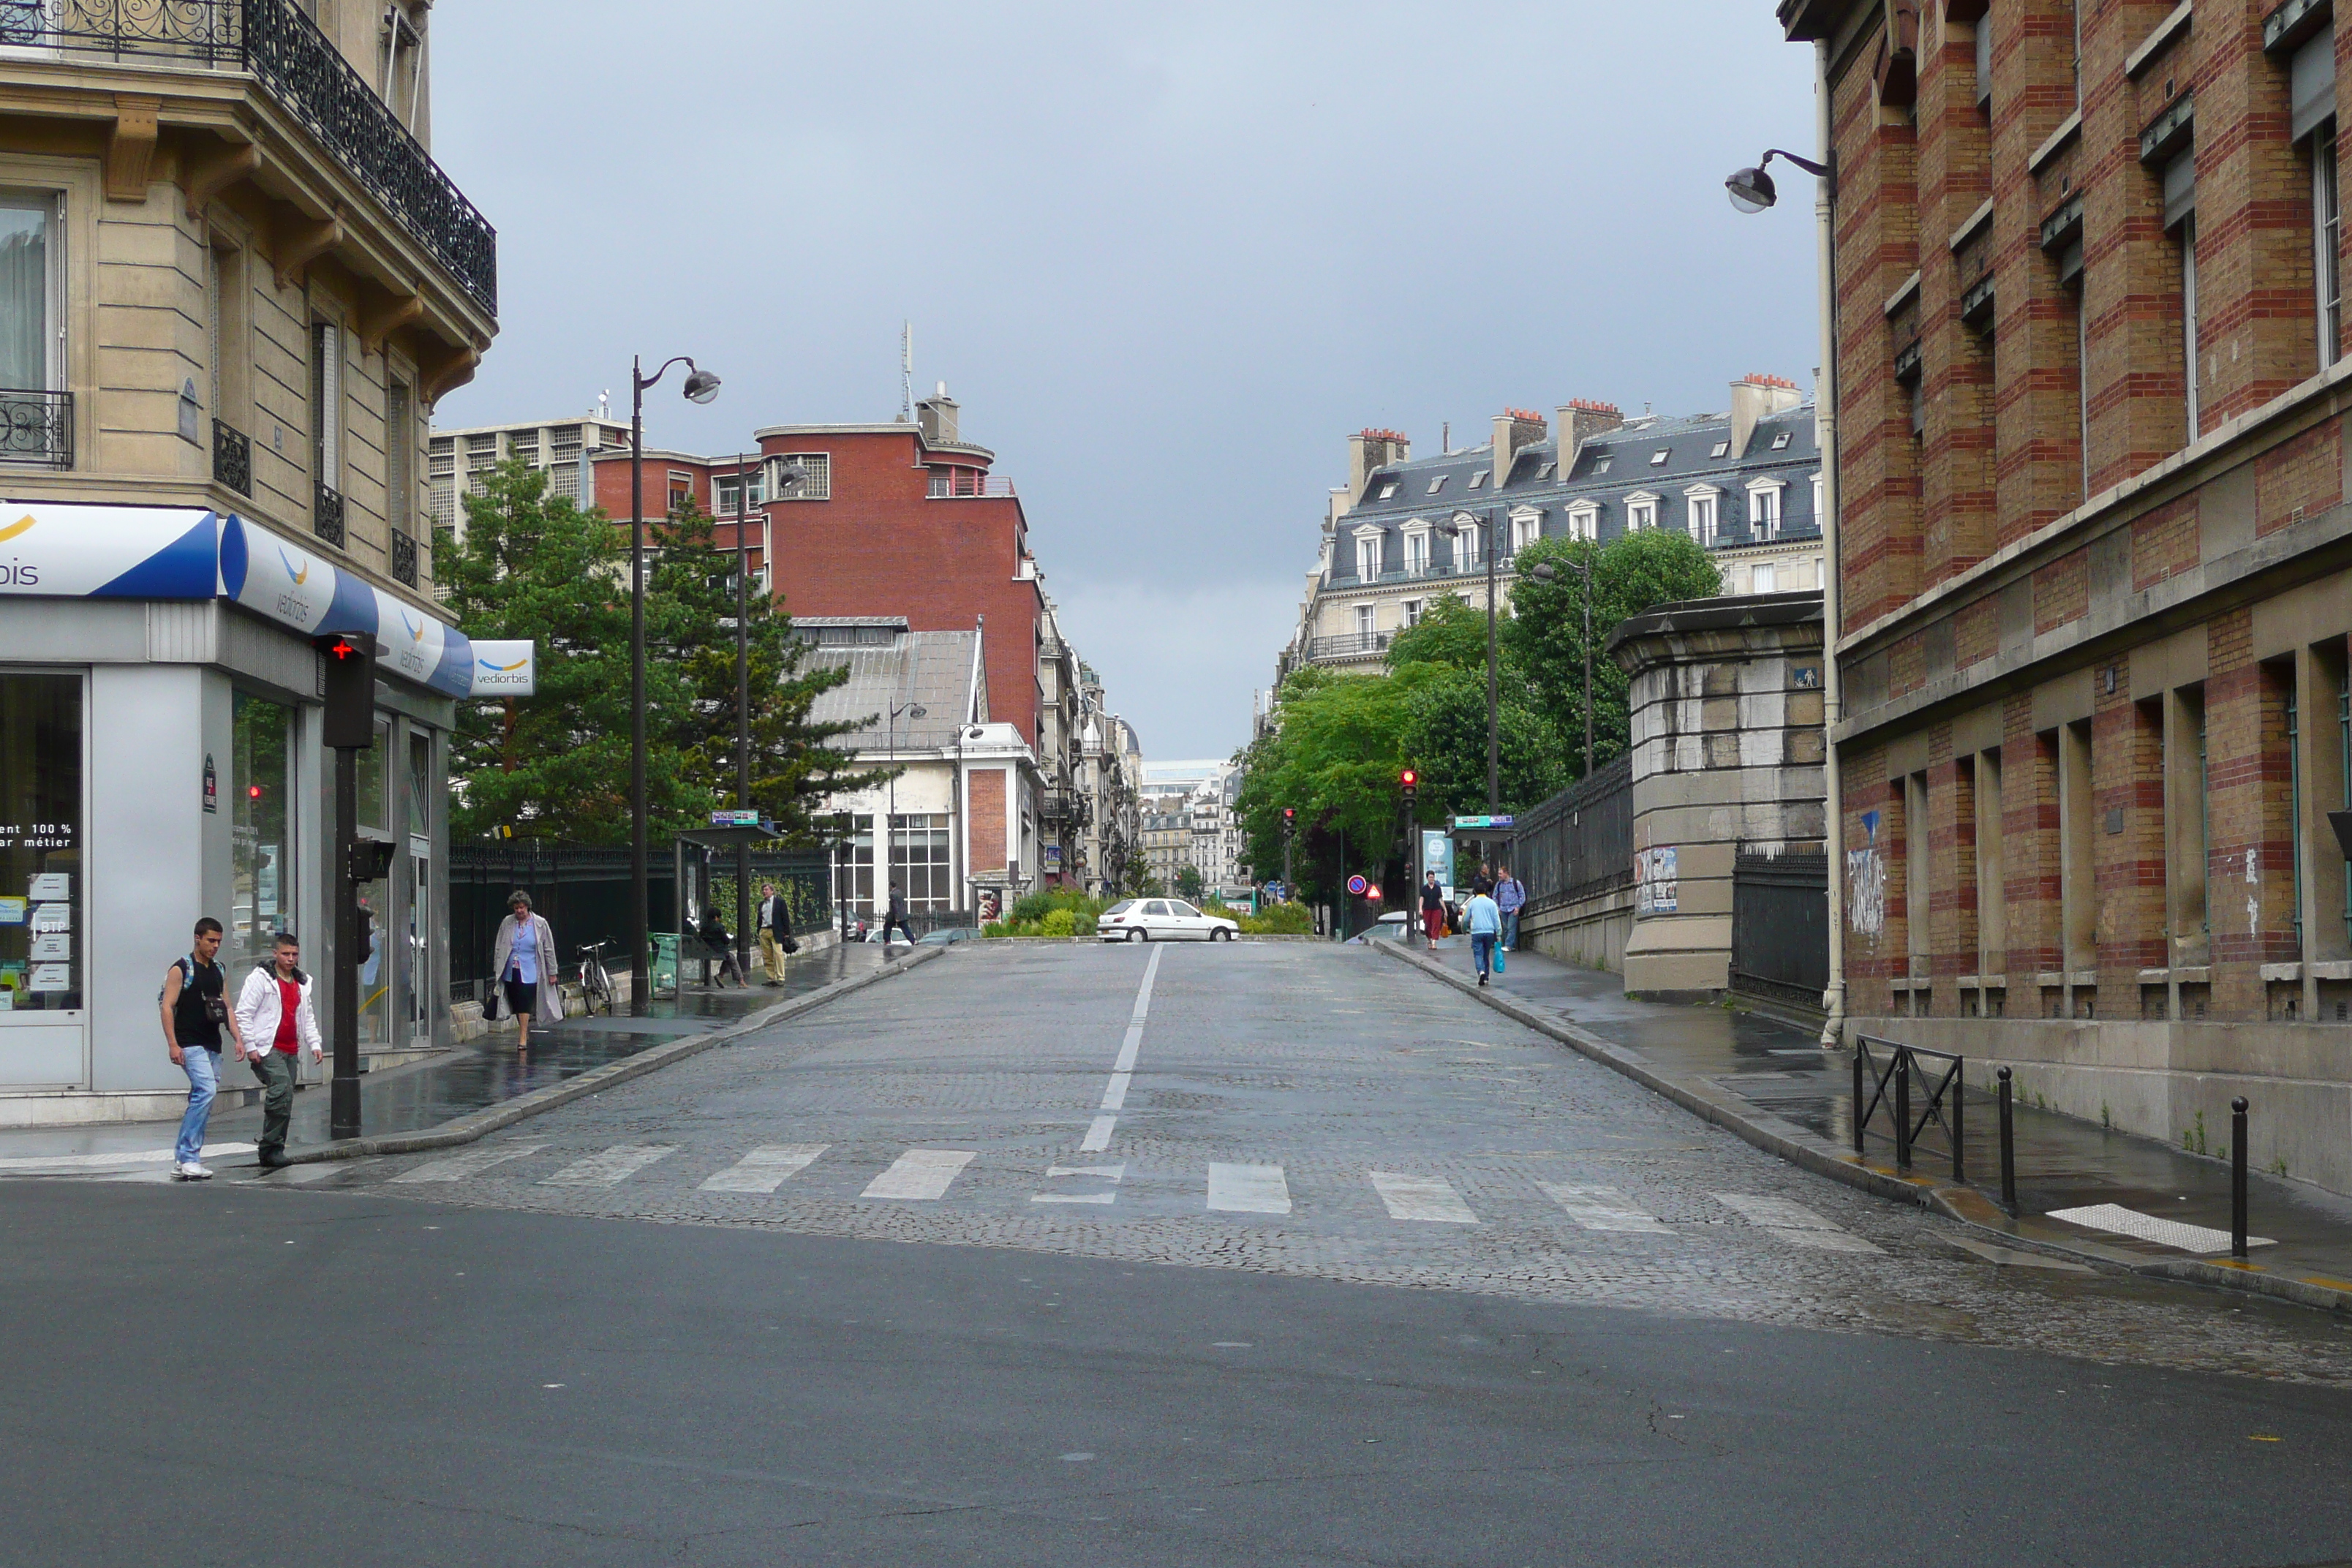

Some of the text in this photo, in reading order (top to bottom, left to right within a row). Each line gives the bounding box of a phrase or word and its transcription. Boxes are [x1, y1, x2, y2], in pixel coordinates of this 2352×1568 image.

[276, 590, 309, 622] vediorbis
[477, 673, 529, 684] vediorbis
[32, 824, 55, 834] 100
[61, 823, 72, 834] %
[24, 837, 71, 847] métier
[41, 921, 66, 932] BTP
